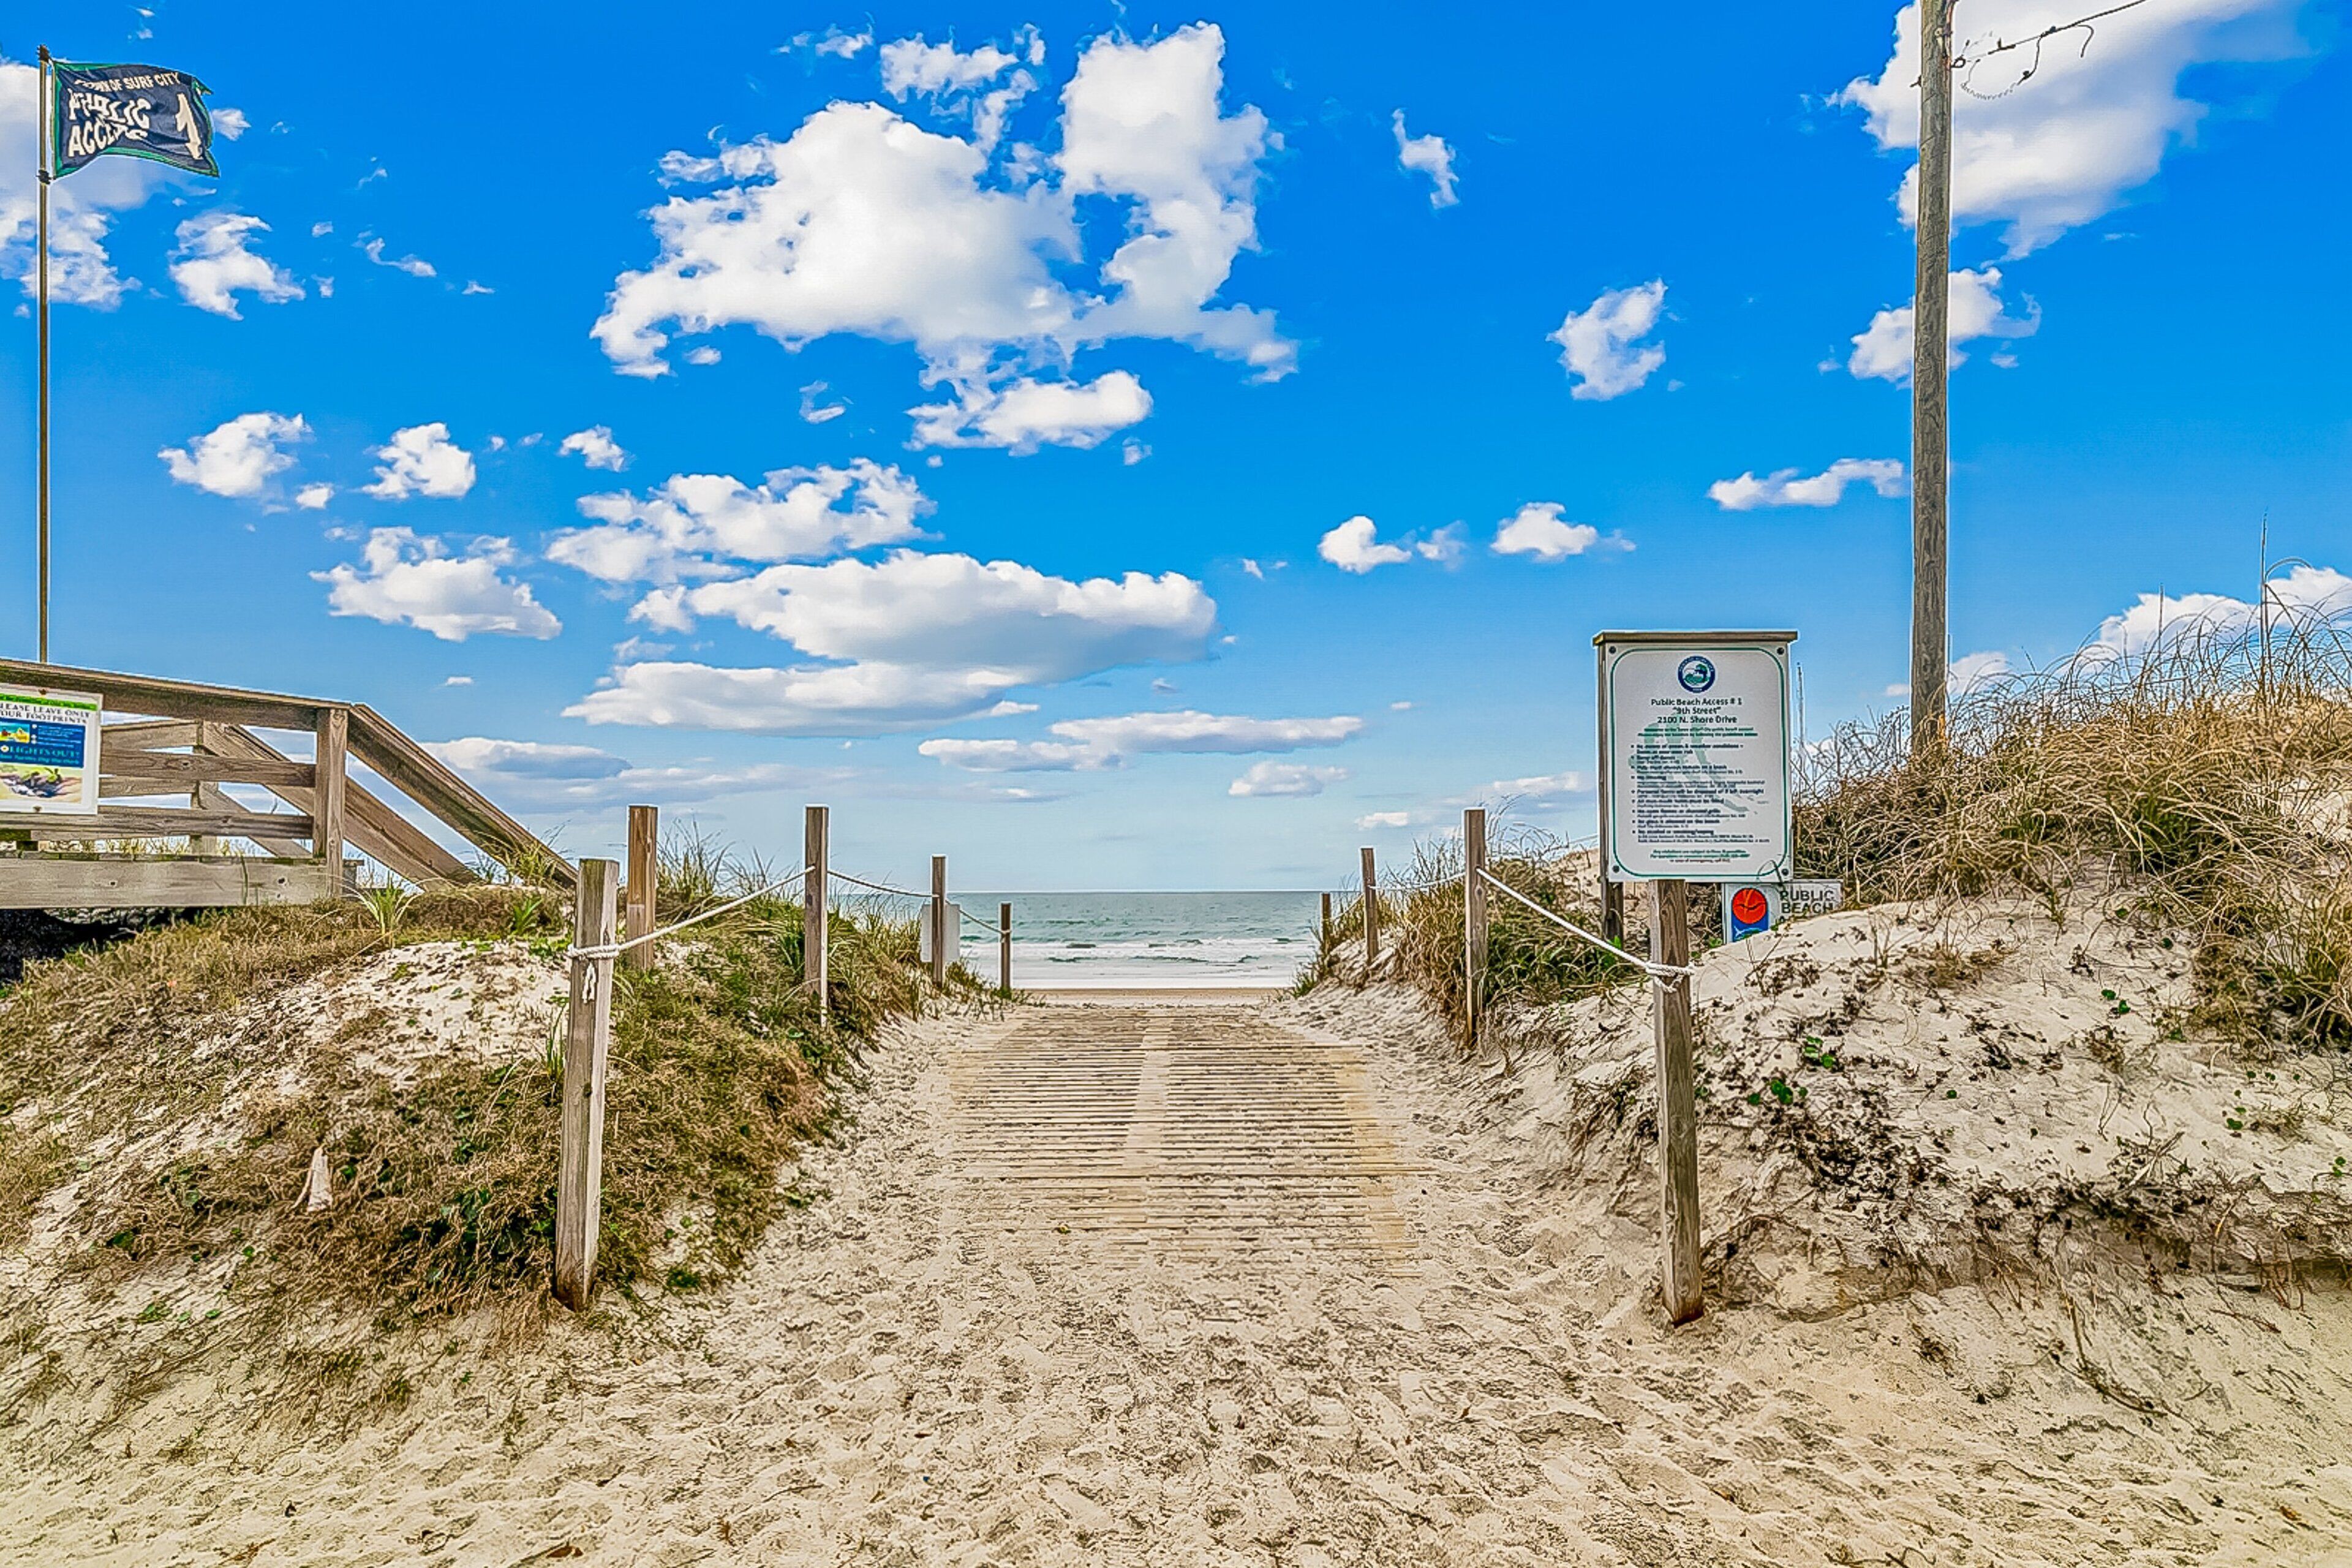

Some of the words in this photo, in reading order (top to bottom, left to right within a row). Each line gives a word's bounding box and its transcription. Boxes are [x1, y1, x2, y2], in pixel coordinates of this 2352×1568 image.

[108, 78, 123, 91] OF
[123, 74, 154, 90] SURF
[154, 72, 181, 86] CITY
[175, 92, 203, 160] 1
[0, 703, 30, 712] LEASE
[34, 706, 61, 715] LEAVE
[65, 709, 90, 718] ONLY
[26, 712, 87, 724] FOOTPRINTS
[1691, 715, 1714, 723] Shore
[1779, 890, 1834, 902] PUBLIC
[1781, 902, 1833, 914] BEACH
